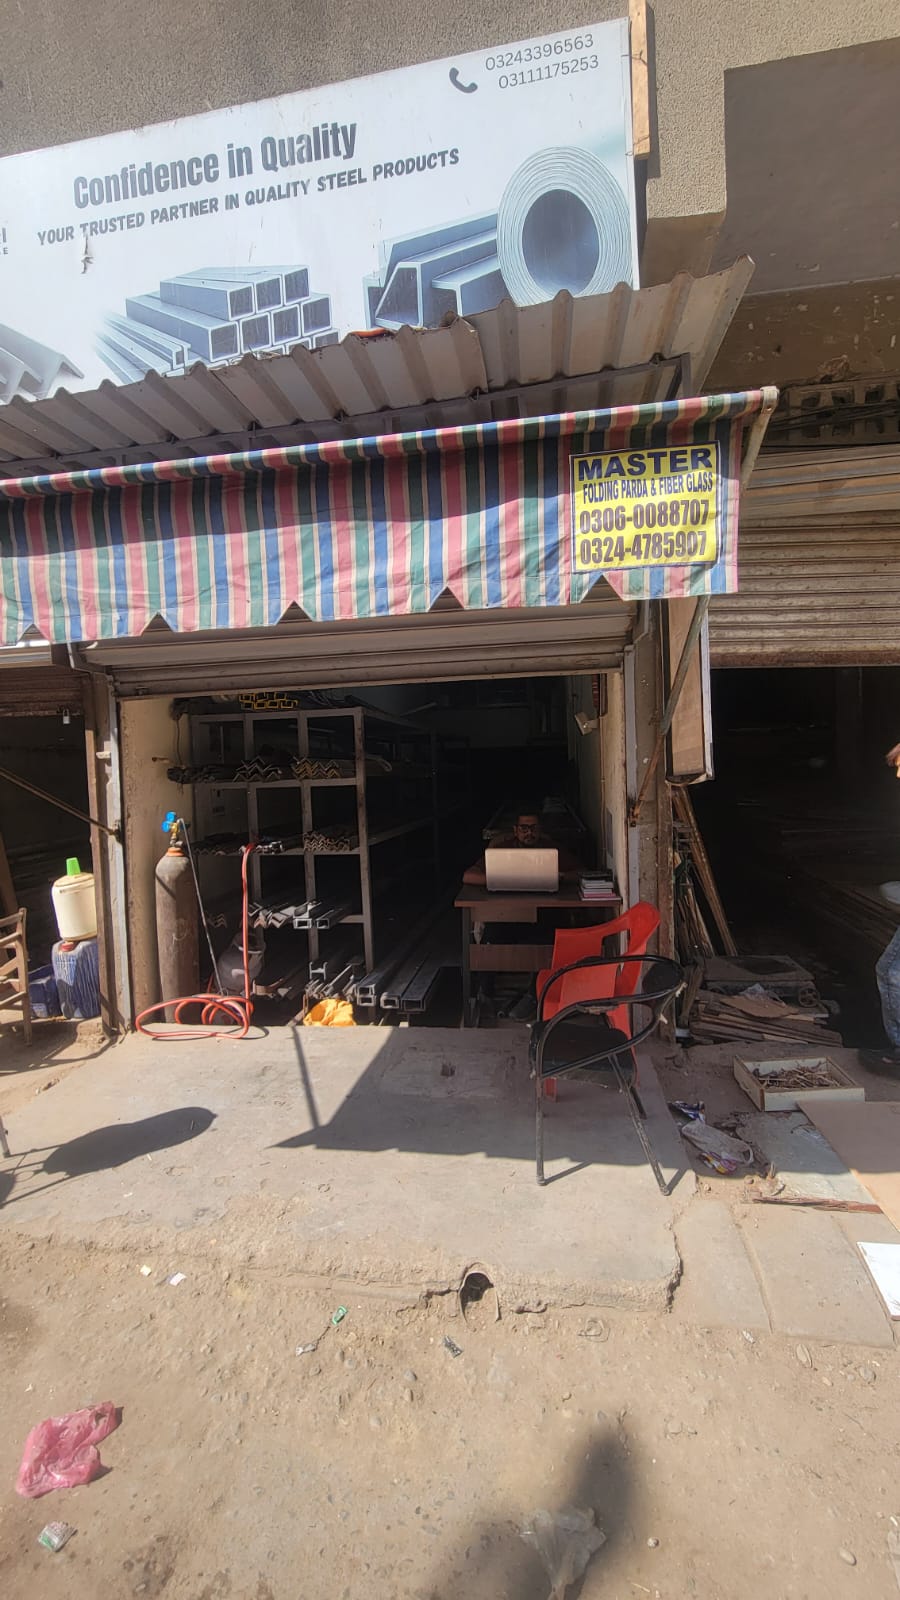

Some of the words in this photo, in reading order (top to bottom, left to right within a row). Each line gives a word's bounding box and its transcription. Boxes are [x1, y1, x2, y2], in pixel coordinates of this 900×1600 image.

[485, 33, 594, 71] 03243396563
[498, 54, 599, 89] 03111175253
[73, 153, 220, 209] Confidence
[228, 143, 253, 179] in
[261, 121, 358, 172] Quality
[37, 225, 75, 246] YOUR
[80, 212, 145, 237] TRUSTED
[150, 197, 219, 226] PARTNER
[224, 193, 240, 211] IN
[244, 178, 311, 206] QUALITY
[317, 168, 368, 193] STEEL
[373, 148, 459, 182] PRODUCTS
[579, 448, 712, 481] MASTER
[583, 479, 619, 504] FOLDING
[621, 478, 649, 499] PARDA
[650, 478, 657, 497] &
[659, 475, 684, 496] FIBER
[686, 472, 713, 493] GLASS
[579, 499, 710, 535] 0306-0088707
[580, 531, 707, 565] 0324-4785907
